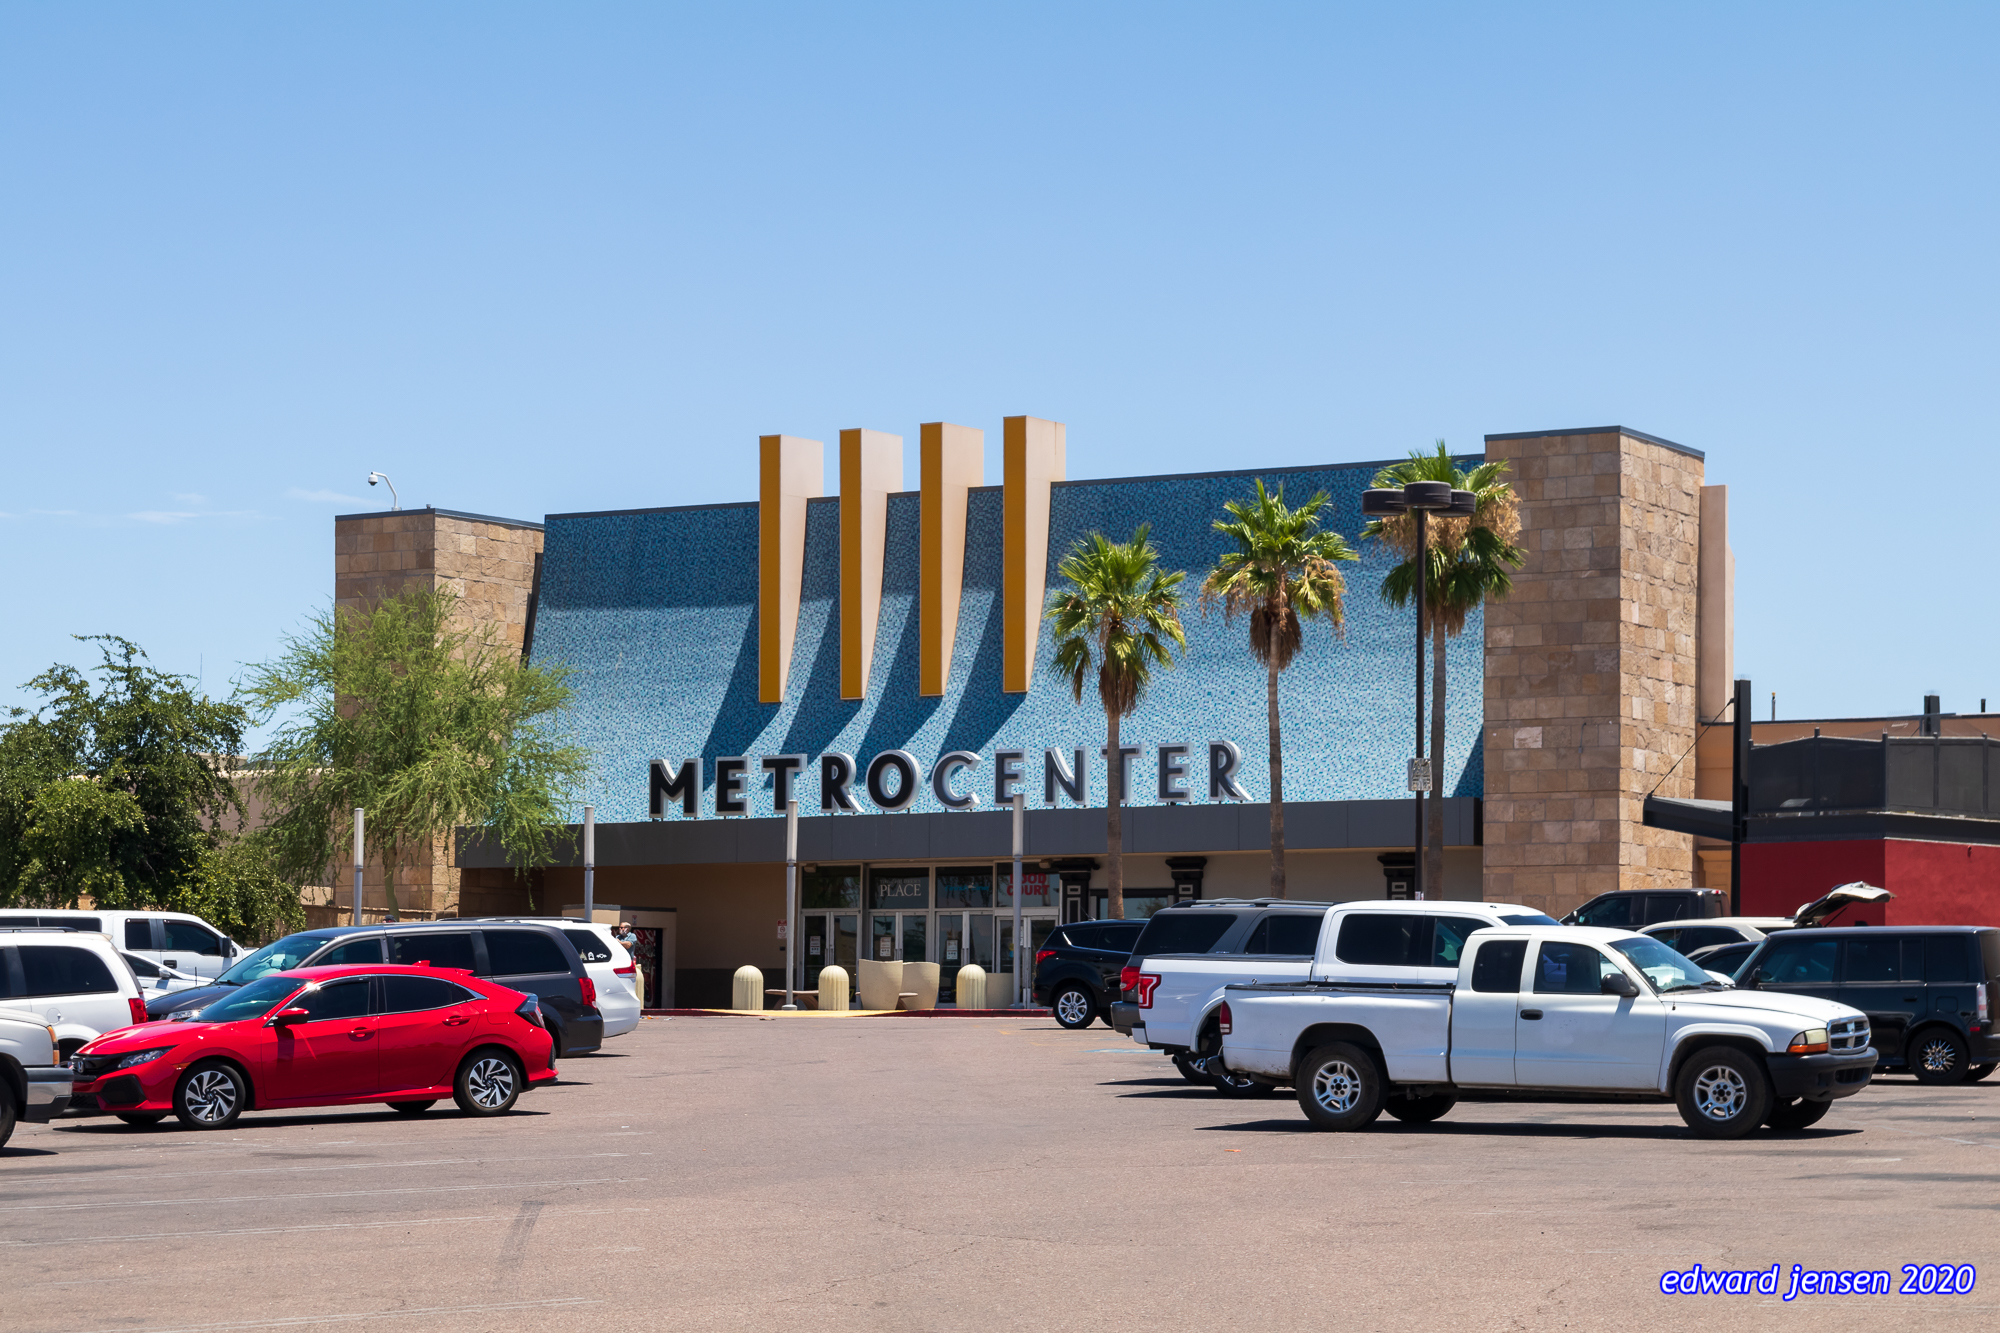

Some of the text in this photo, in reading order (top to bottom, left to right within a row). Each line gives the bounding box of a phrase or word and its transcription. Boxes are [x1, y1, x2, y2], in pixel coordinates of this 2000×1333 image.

[649, 740, 1253, 818] METROCENTER
[880, 884, 921, 896] PLACE
[1006, 884, 1050, 896] CURT
